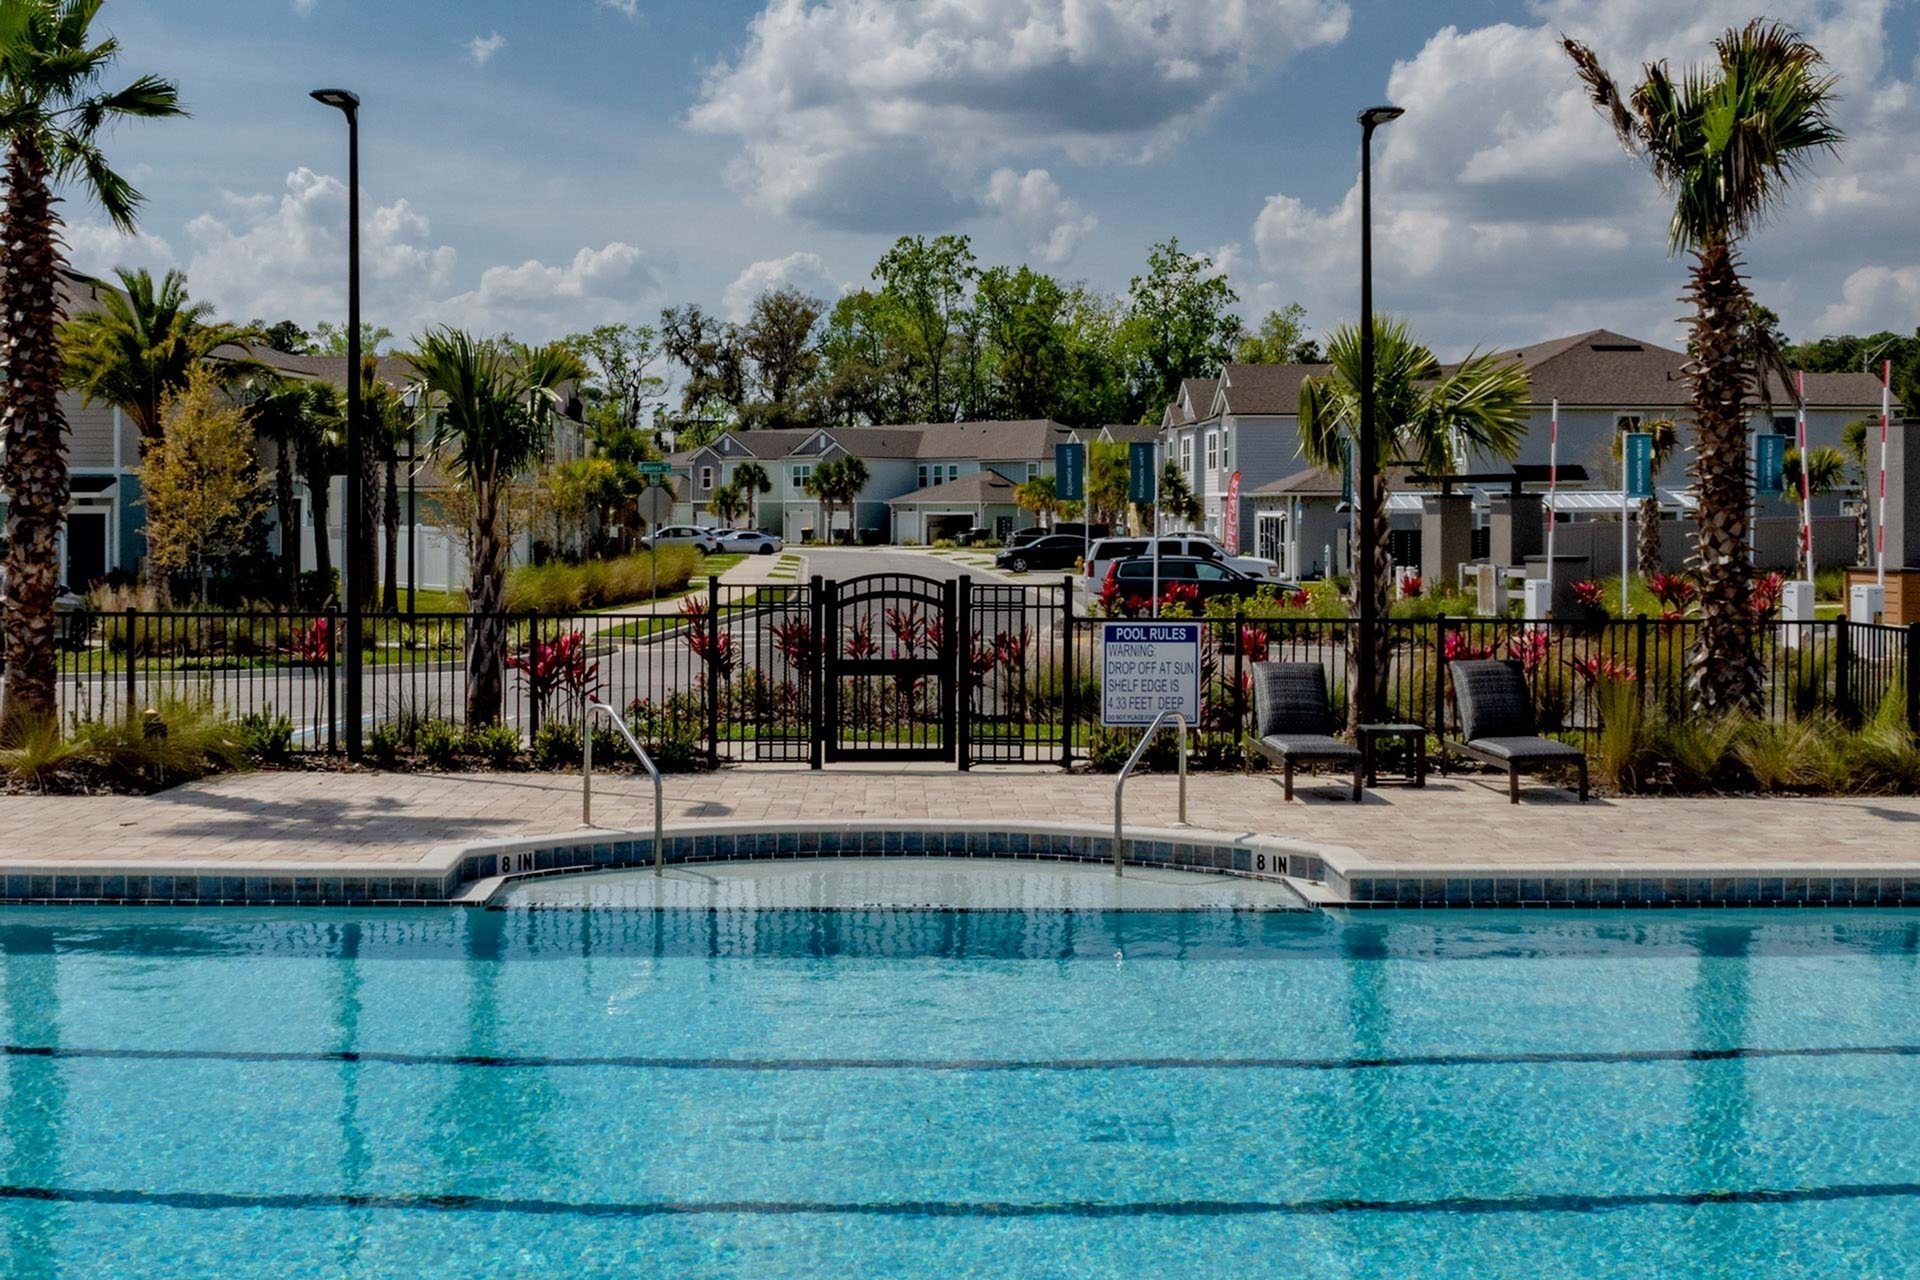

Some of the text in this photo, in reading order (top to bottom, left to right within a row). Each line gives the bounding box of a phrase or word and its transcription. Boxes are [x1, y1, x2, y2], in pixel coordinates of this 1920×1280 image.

[1225, 480, 1240, 556] SPECIALS
[1116, 627, 1187, 640] POOL RULES
[1108, 644, 1157, 657] WARNING:
[1108, 661, 1194, 675] DROP OFF AT SUN
[1108, 679, 1180, 692] SHELF EDGE IS
[1108, 696, 1184, 710] 4.33 FEET DEEP
[502, 853, 532, 873] 8 IN
[1257, 854, 1287, 874] 8 IN
